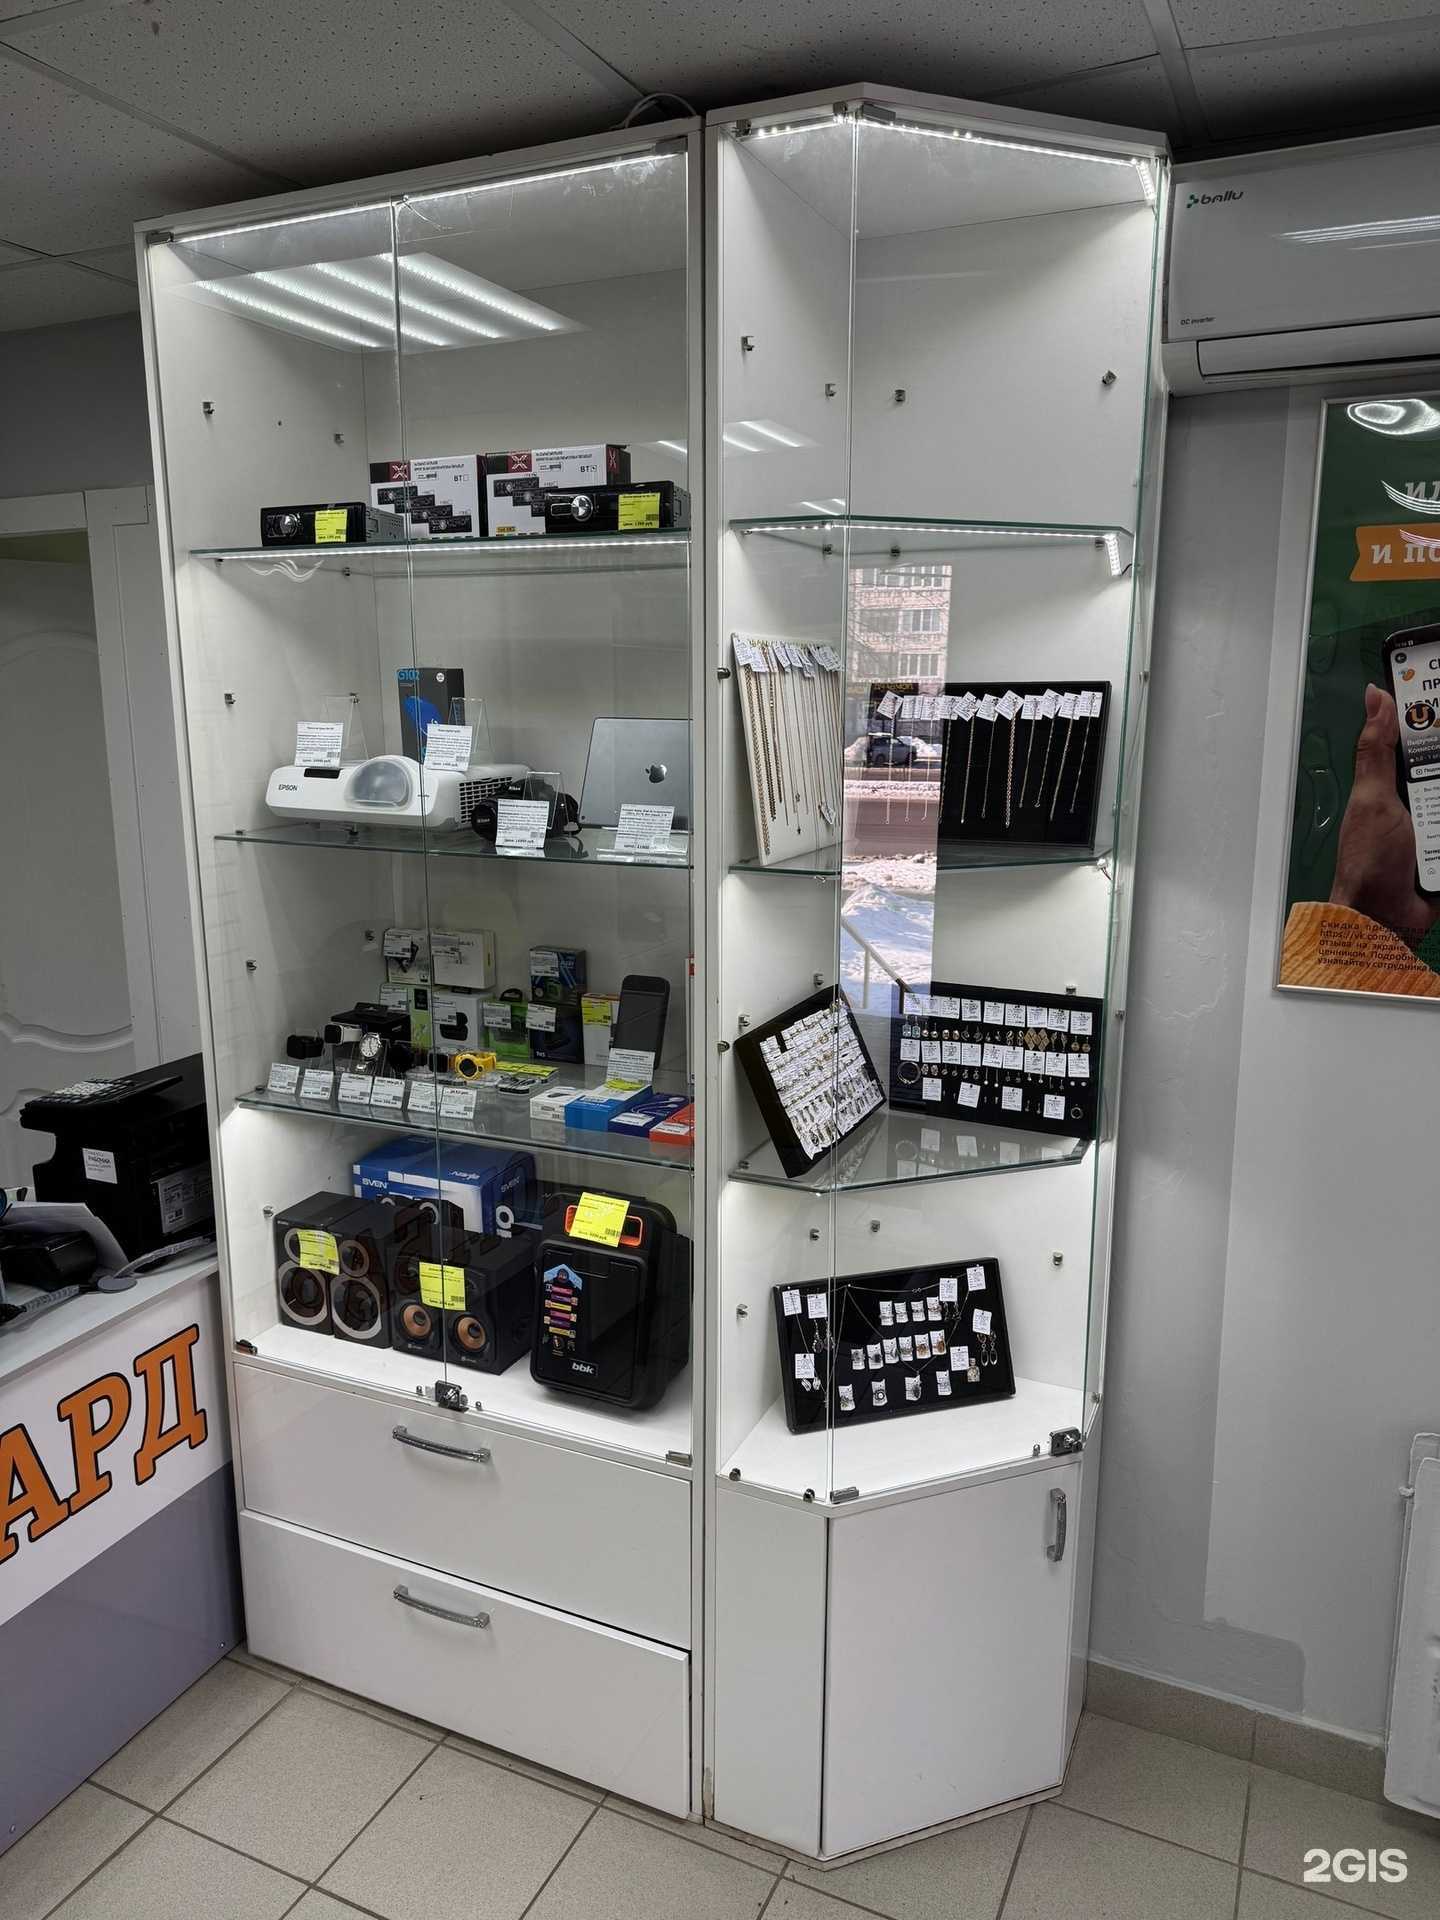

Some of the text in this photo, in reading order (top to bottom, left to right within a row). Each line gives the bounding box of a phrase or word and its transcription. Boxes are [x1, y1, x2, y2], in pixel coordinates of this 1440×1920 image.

[1200, 190, 1244, 205] ballu
[1370, 543, 1393, 565] и
[278, 783, 298, 791] EPSON
[361, 1177, 388, 1189] SVEN
[571, 1361, 595, 1375] bbk
